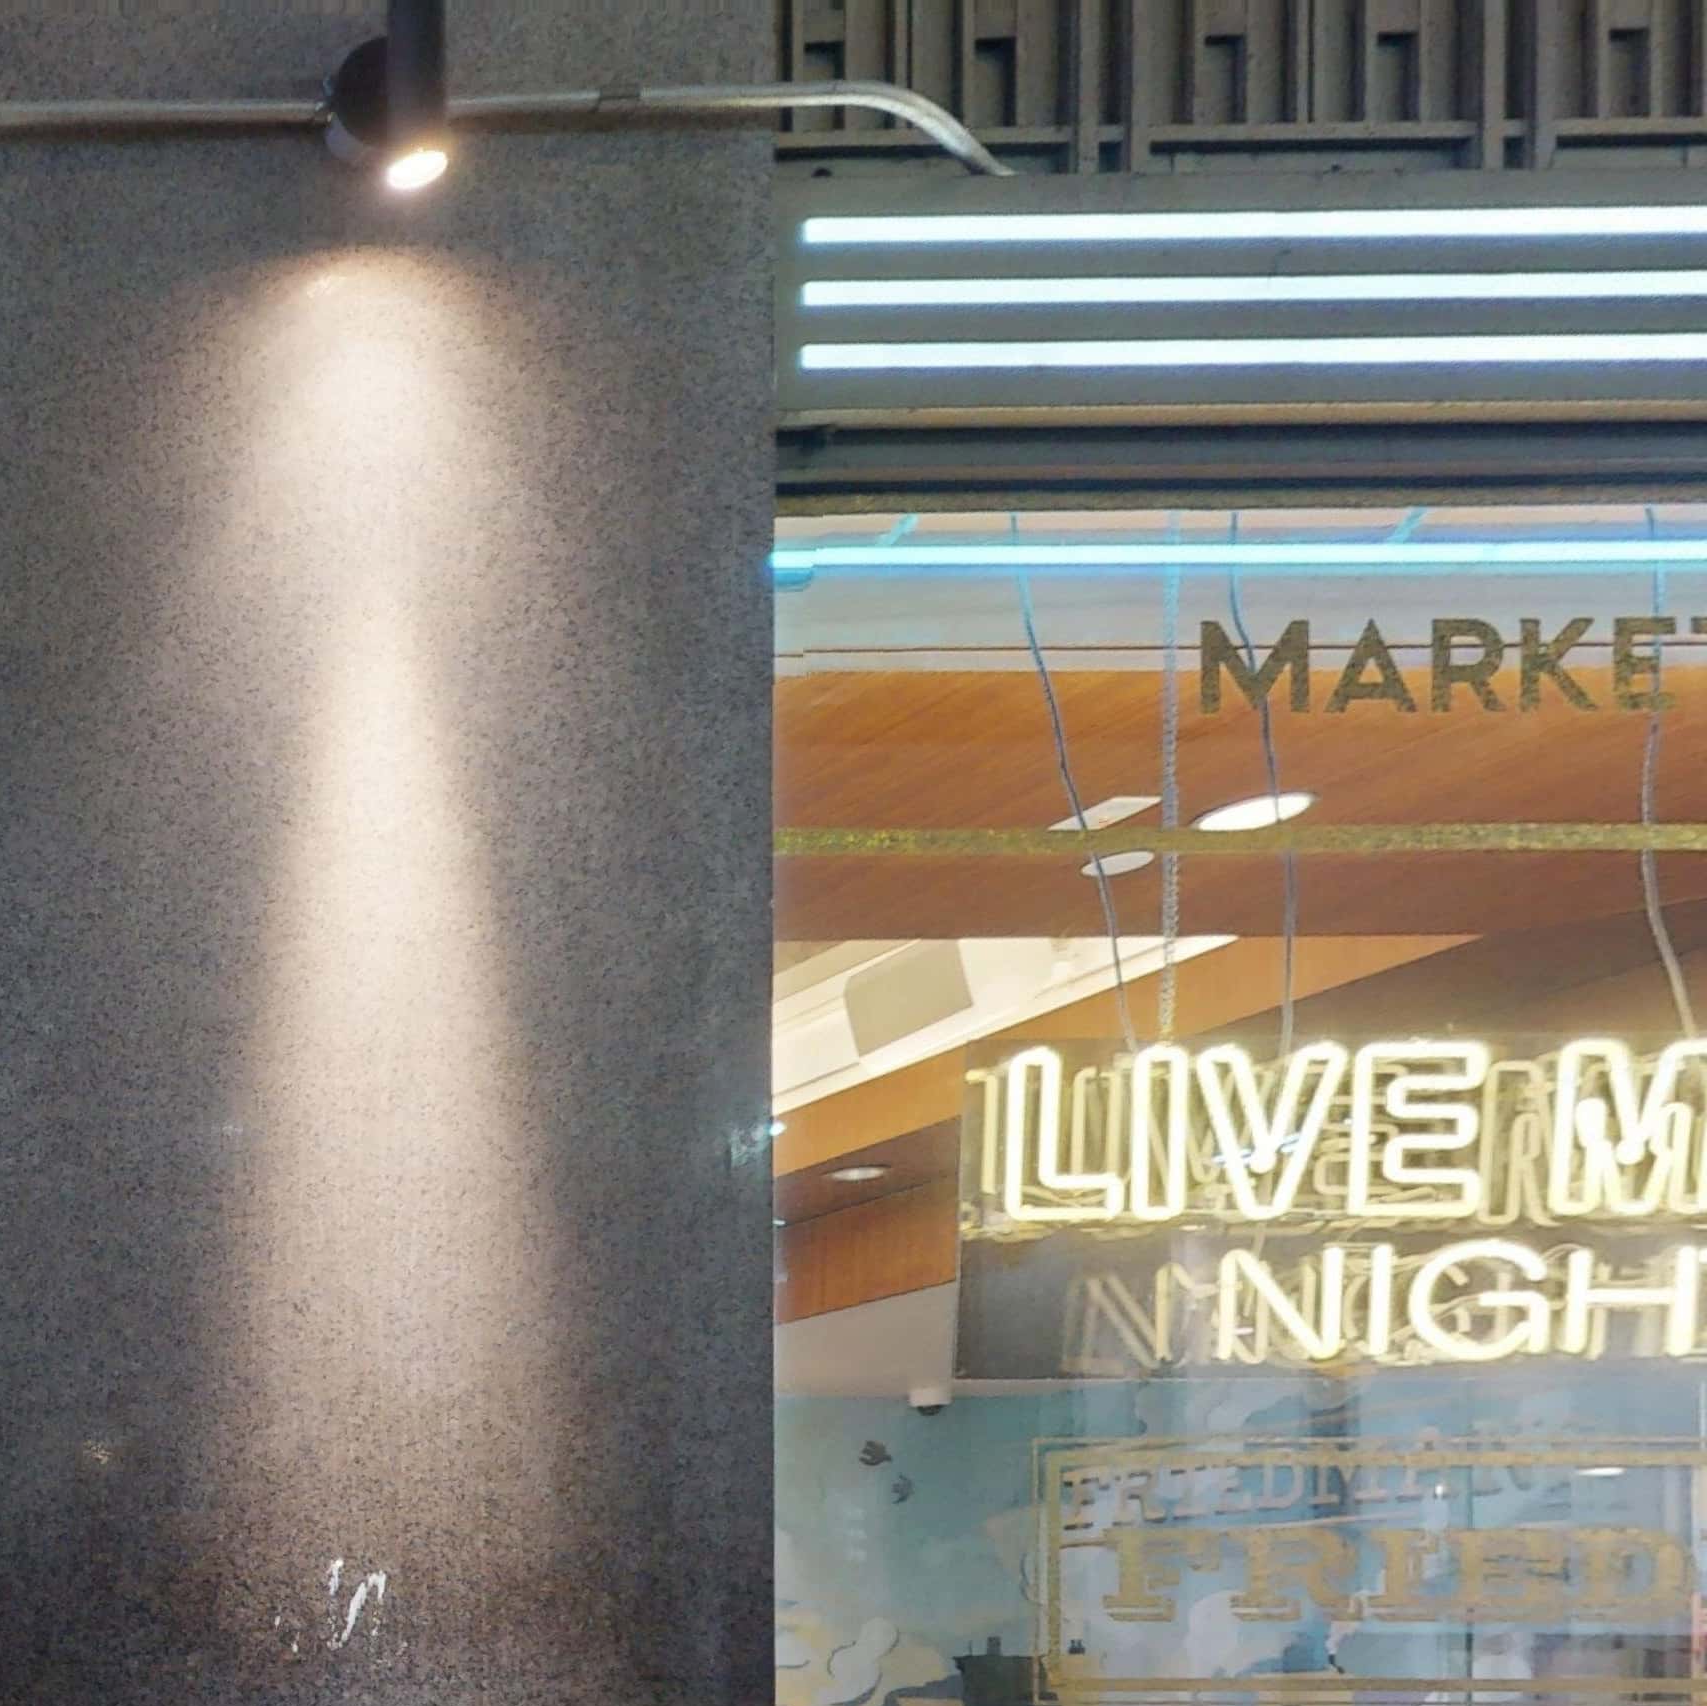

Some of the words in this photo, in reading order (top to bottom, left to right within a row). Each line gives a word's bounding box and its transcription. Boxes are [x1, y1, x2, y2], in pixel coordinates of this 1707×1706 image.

[1199, 617, 1706, 712] MARKE
[1003, 1038, 1489, 1221] LIVE
[1218, 1239, 1706, 1361] NIGH
